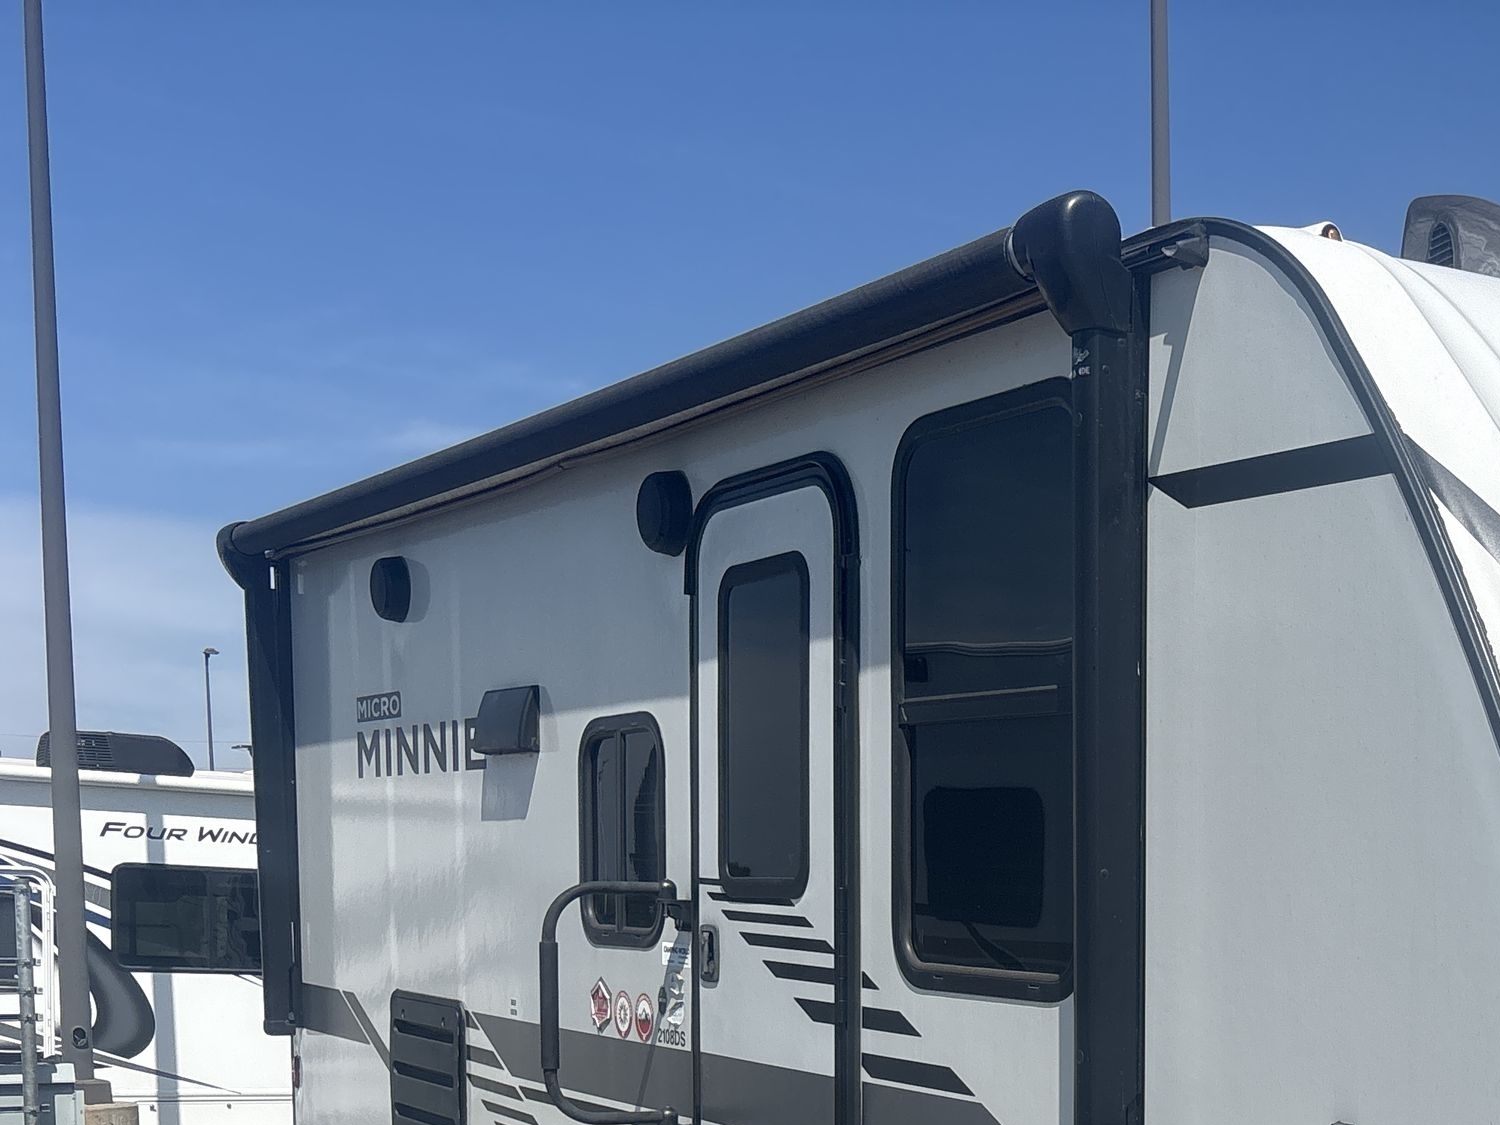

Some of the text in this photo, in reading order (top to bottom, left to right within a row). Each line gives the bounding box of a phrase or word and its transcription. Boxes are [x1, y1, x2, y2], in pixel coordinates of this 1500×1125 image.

[358, 694, 400, 720] MICRO
[357, 718, 487, 779] MINNIE
[100, 821, 188, 841] FOUR
[657, 1028, 686, 1047] 2108DS
